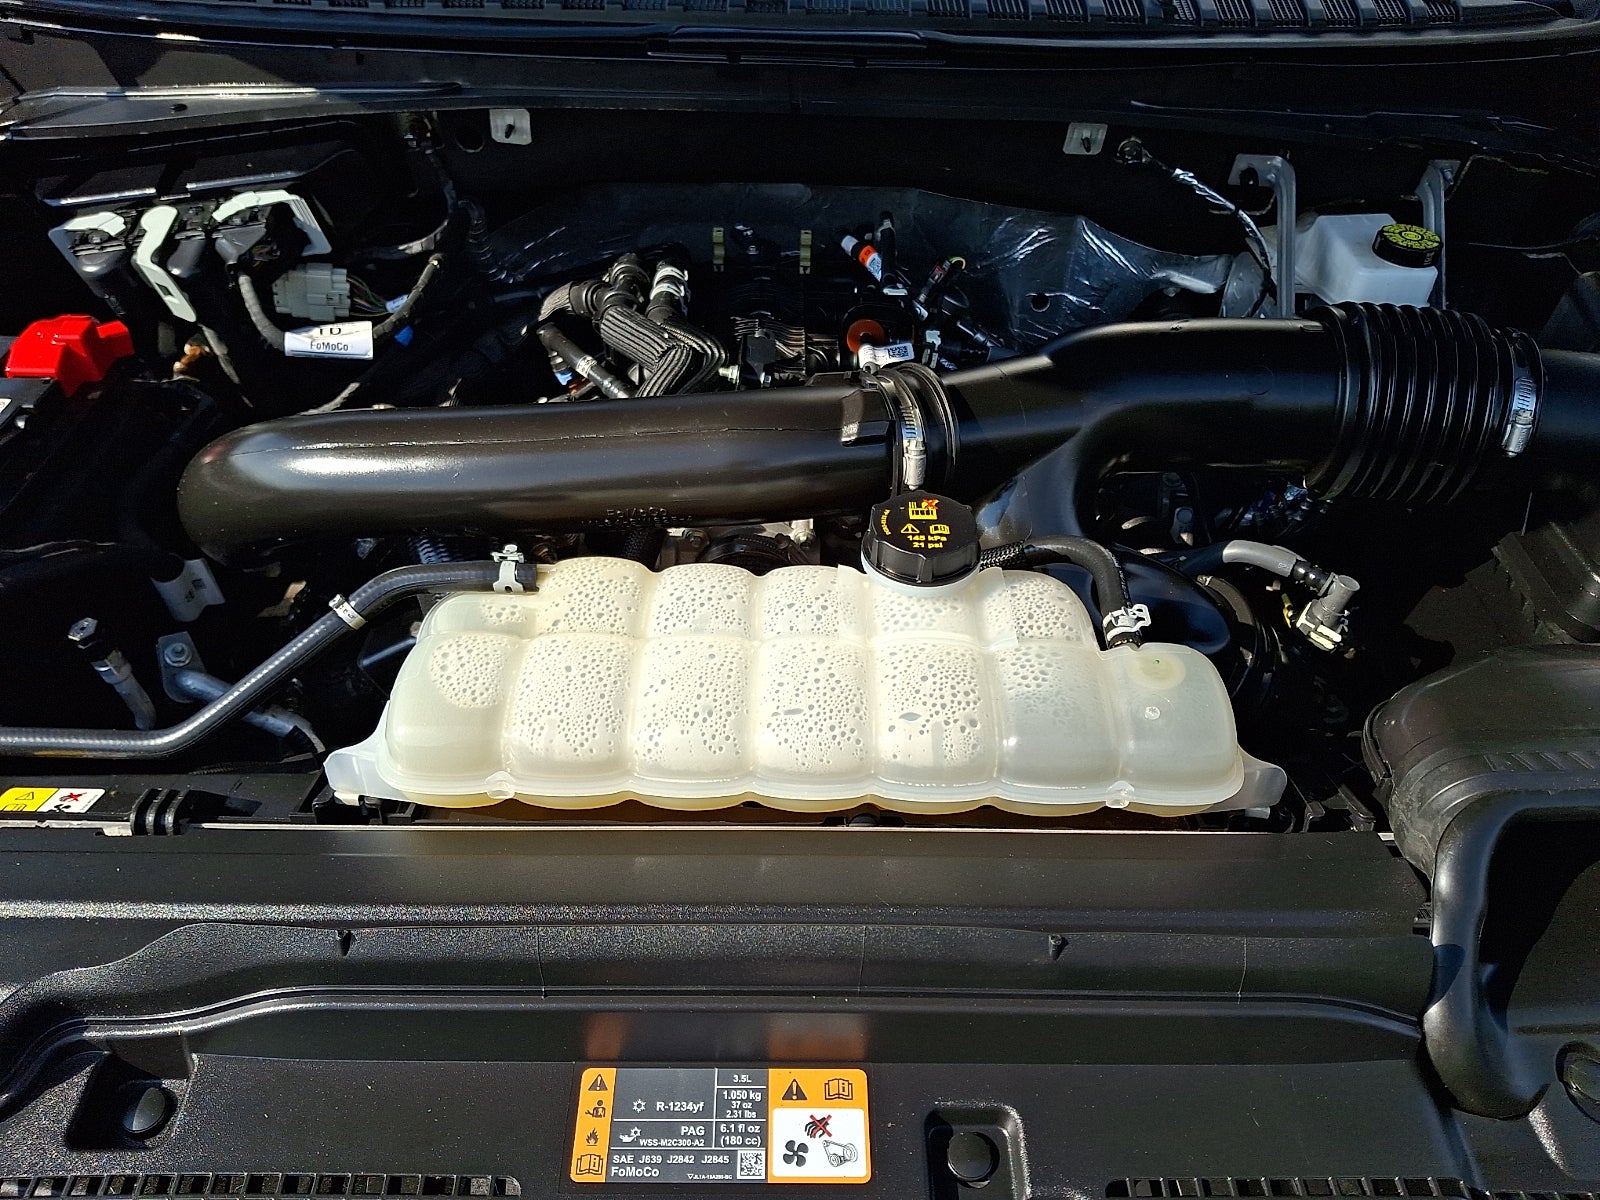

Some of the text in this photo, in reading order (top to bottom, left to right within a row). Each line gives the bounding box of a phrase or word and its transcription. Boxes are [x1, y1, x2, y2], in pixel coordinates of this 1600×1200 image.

[310, 342, 349, 352] FoMoCo
[733, 1074, 752, 1083] 3.5L
[723, 1090, 762, 1102] 1.050 kg
[656, 1101, 705, 1113] R-1234yf
[731, 1101, 741, 1109] 37
[726, 1110, 757, 1119] 2.31 lbs
[680, 1126, 705, 1136] PAG
[720, 1123, 761, 1133] 6.1 fl oz
[639, 1139, 705, 1147] WSS-M2C300-A2
[720, 1136, 761, 1147] (180 cc)
[612, 1155, 730, 1164] SAE J639 J2842 J2845
[611, 1166, 660, 1177] FoMoCo
